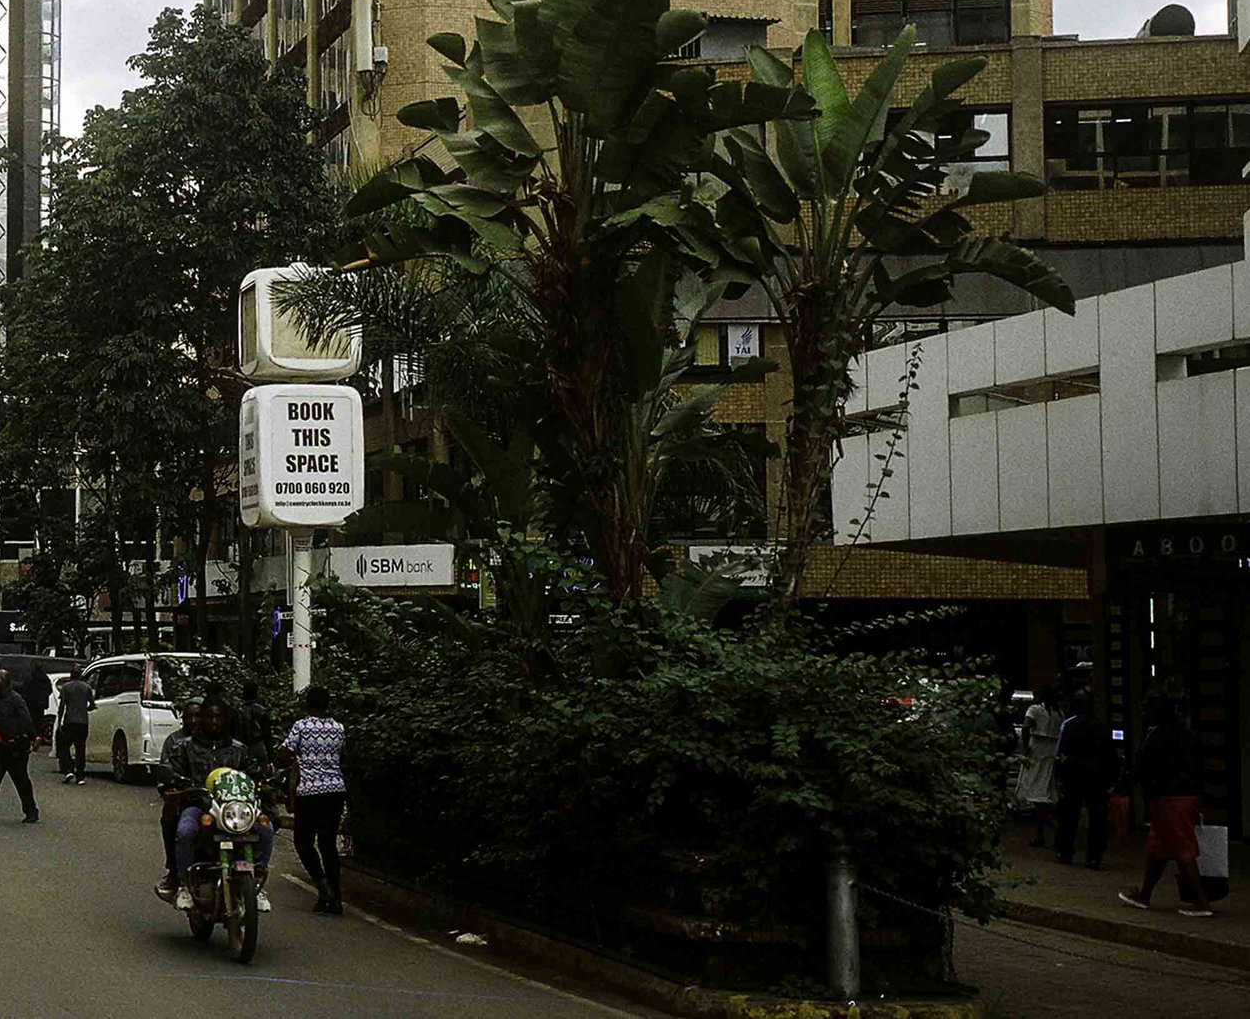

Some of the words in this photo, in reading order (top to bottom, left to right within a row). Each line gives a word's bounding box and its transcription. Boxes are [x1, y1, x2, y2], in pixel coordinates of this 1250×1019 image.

[288, 402, 335, 421] BOOK
[292, 428, 331, 447] THIS
[286, 454, 339, 473] SPACE
[275, 482, 302, 494] 0700
[305, 482, 326, 494] 060
[328, 482, 350, 494] 920
[370, 558, 404, 574] SBM
[406, 558, 434, 573] bank
